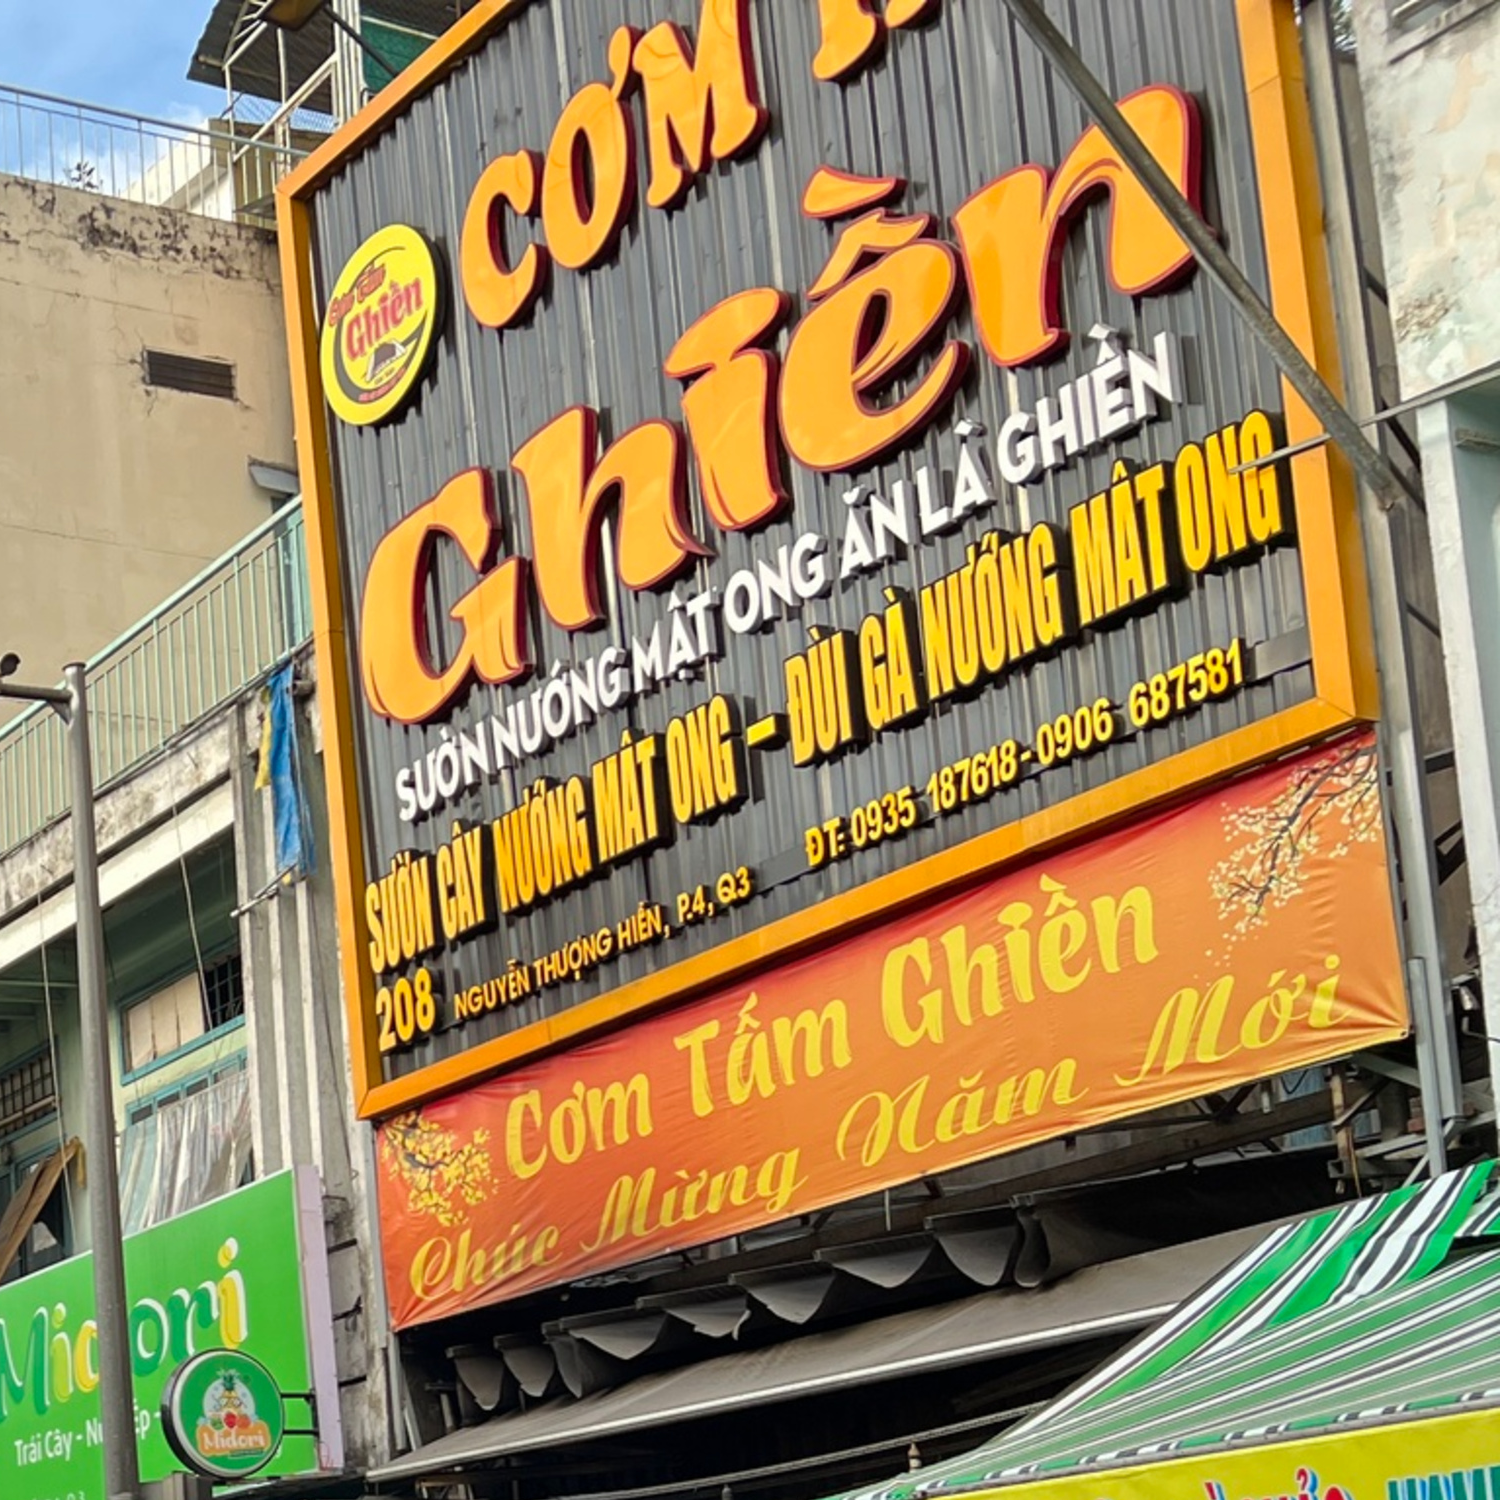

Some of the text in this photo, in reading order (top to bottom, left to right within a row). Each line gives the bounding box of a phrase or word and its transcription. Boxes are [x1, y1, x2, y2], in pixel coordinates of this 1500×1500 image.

[461, 0, 768, 327] CƠM
[362, 83, 1218, 724] Ghiền
[366, 850, 436, 975] SƯỜN
[436, 820, 487, 940] CÂY
[492, 776, 592, 915] NƯỚNG
[665, 694, 739, 825] ONG
[784, 627, 853, 767] ĐÙI
[859, 587, 919, 729] GÀ
[919, 522, 1064, 699] NƯỚNG
[1174, 409, 1283, 573] ONG
[395, 323, 1184, 822] SƯỜN NƯỚNG MẬT ONG ĂN LÀ GHIỀN
[805, 637, 1247, 866] ĐT: 0935 687581
[375, 966, 436, 1052] 208
[453, 957, 531, 1021] NGUYỄN
[533, 927, 612, 982] THƯỢNG
[716, 866, 753, 905] Q3
[505, 872, 1159, 1181] Cơm Tấm Ghiền
[408, 953, 1351, 1301] Chúc Mừng Năm Mới
[13, 1430, 42, 1467] Trái
[44, 1425, 73, 1462] Cây
[203, 1430, 266, 1450] Midori
